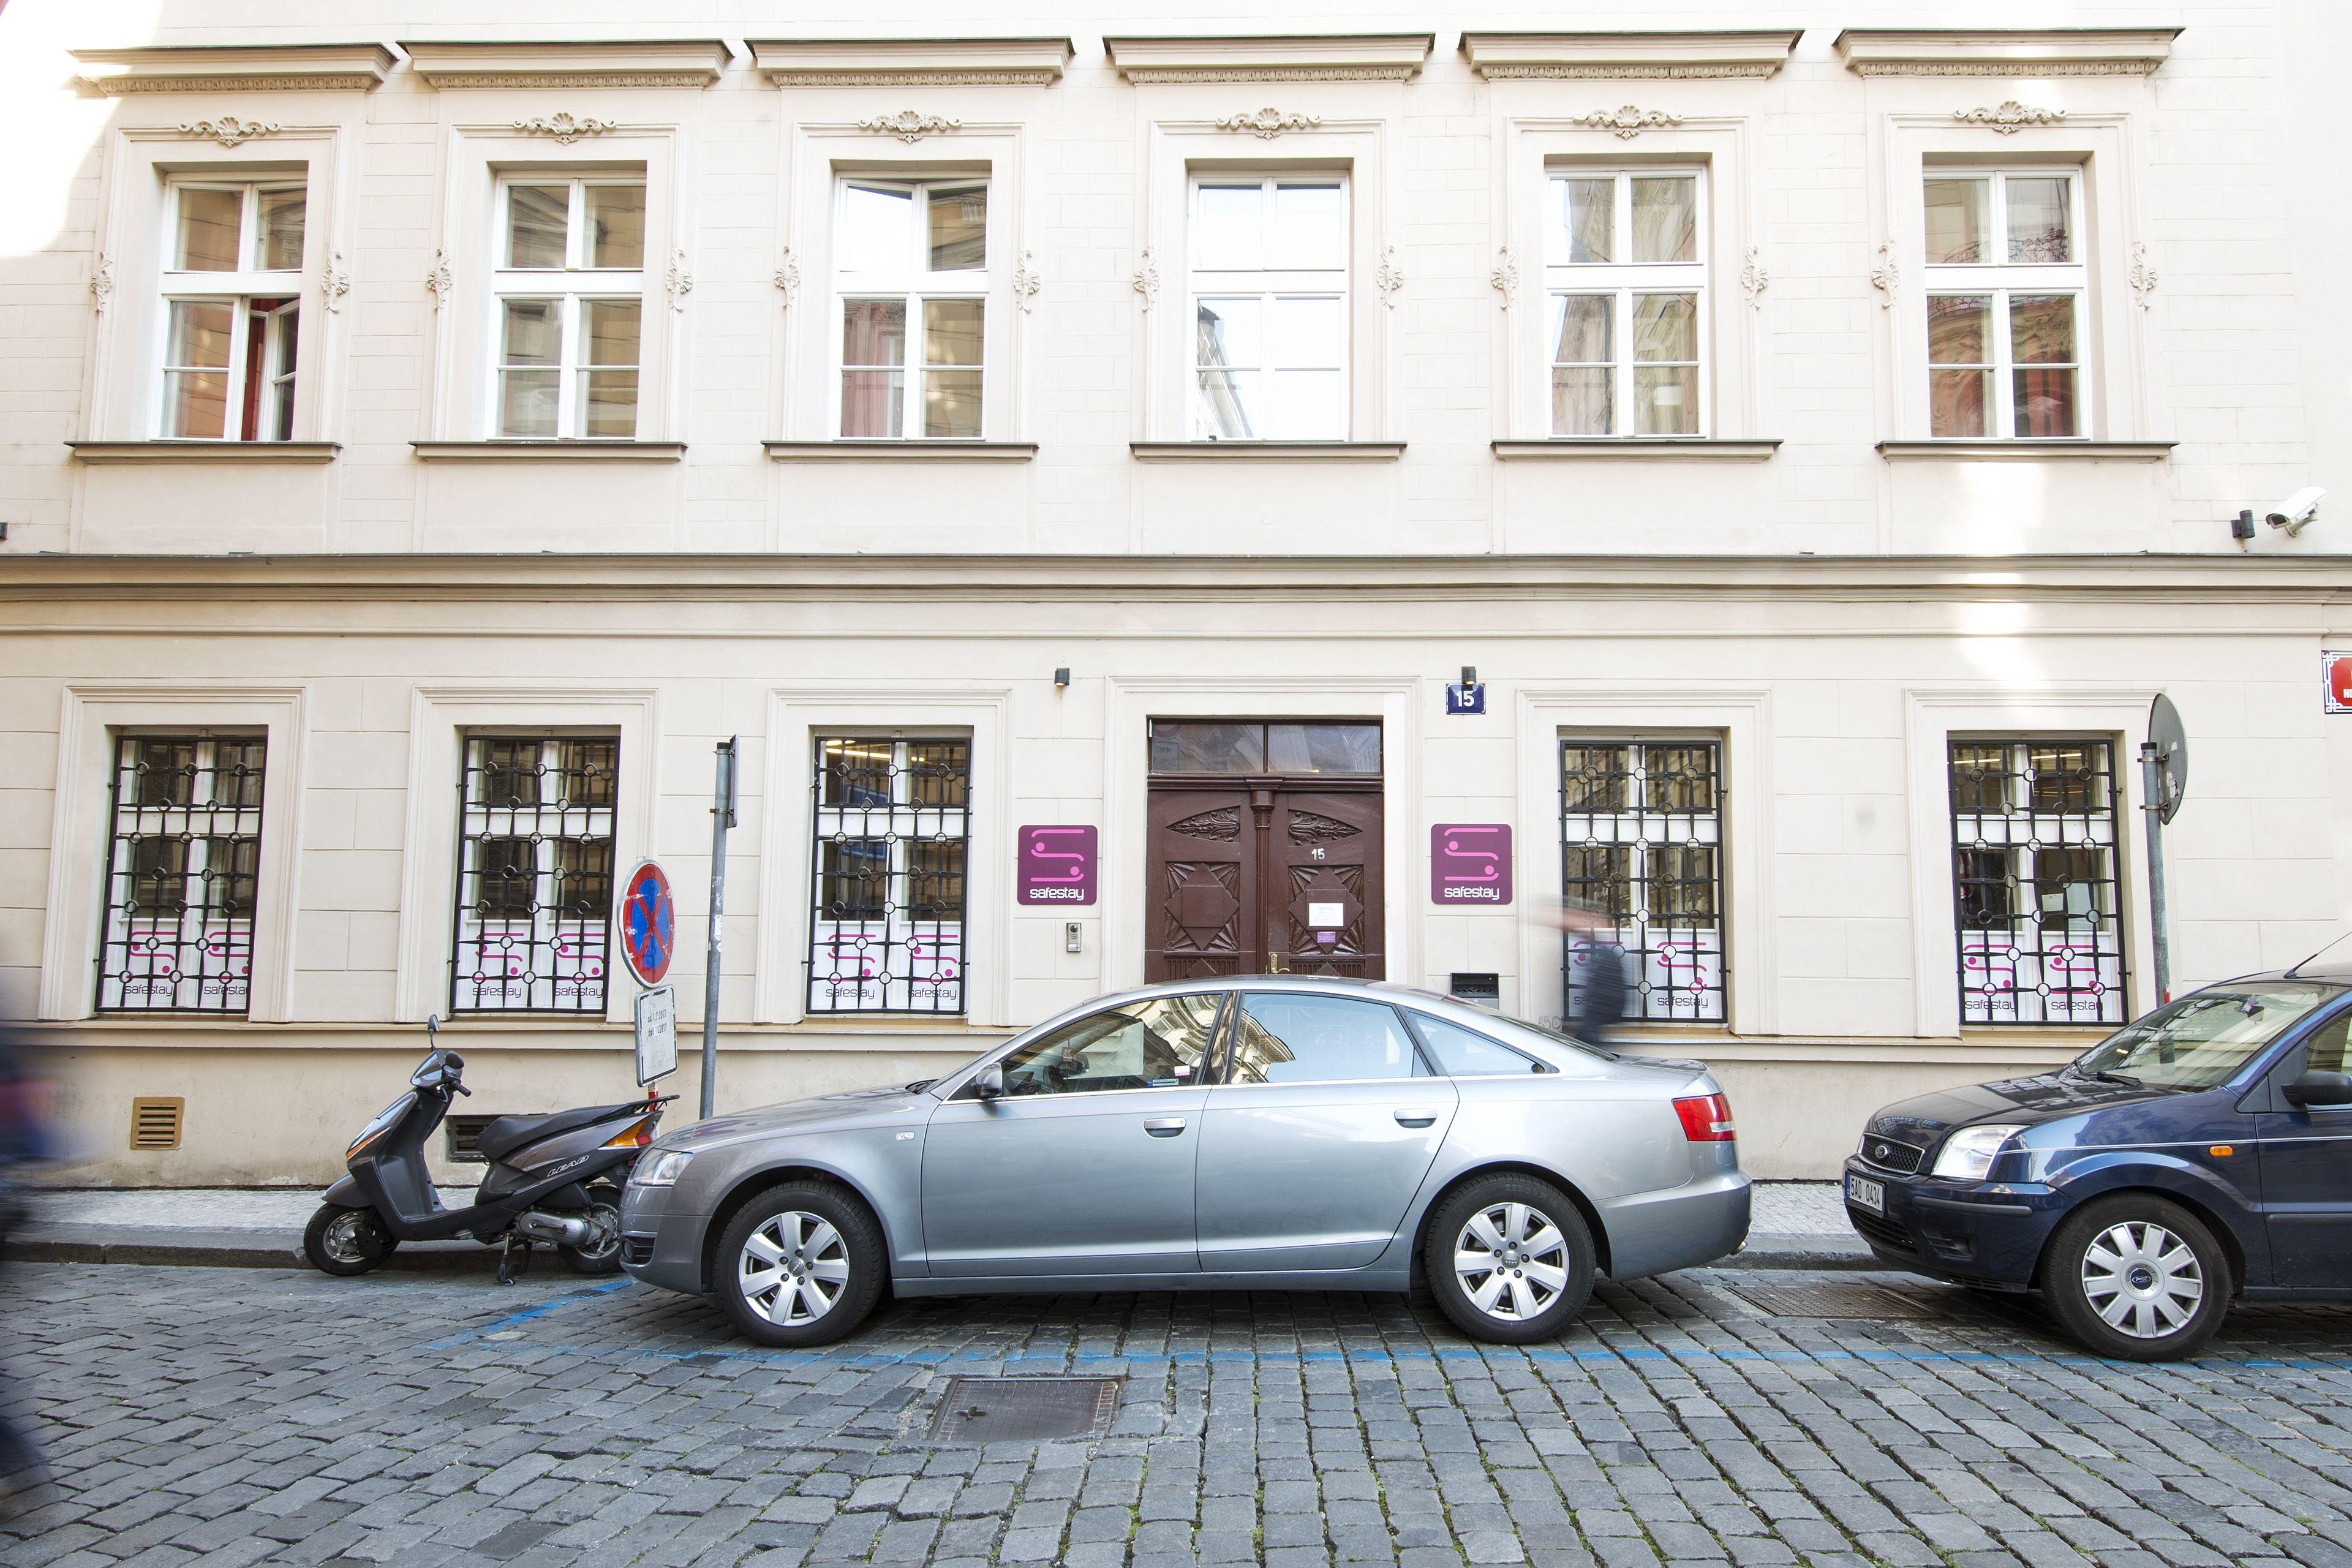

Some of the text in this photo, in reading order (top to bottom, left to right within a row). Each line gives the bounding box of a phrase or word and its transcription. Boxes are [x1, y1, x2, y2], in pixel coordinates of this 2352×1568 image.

[1456, 690, 1475, 707] 15
[1311, 848, 1325, 861] 15
[1030, 887, 1084, 901] safestay
[1444, 886, 1500, 900] safestay
[124, 984, 173, 997] safestay
[472, 986, 522, 998] safesay
[554, 986, 603, 998] safestay
[826, 987, 875, 1000] safesay
[2051, 1000, 2103, 1012] saesta
[547, 1155, 589, 1177] LEAD
[1851, 1178, 1862, 1199] 5AD
[1866, 1183, 1880, 1207] 0434
